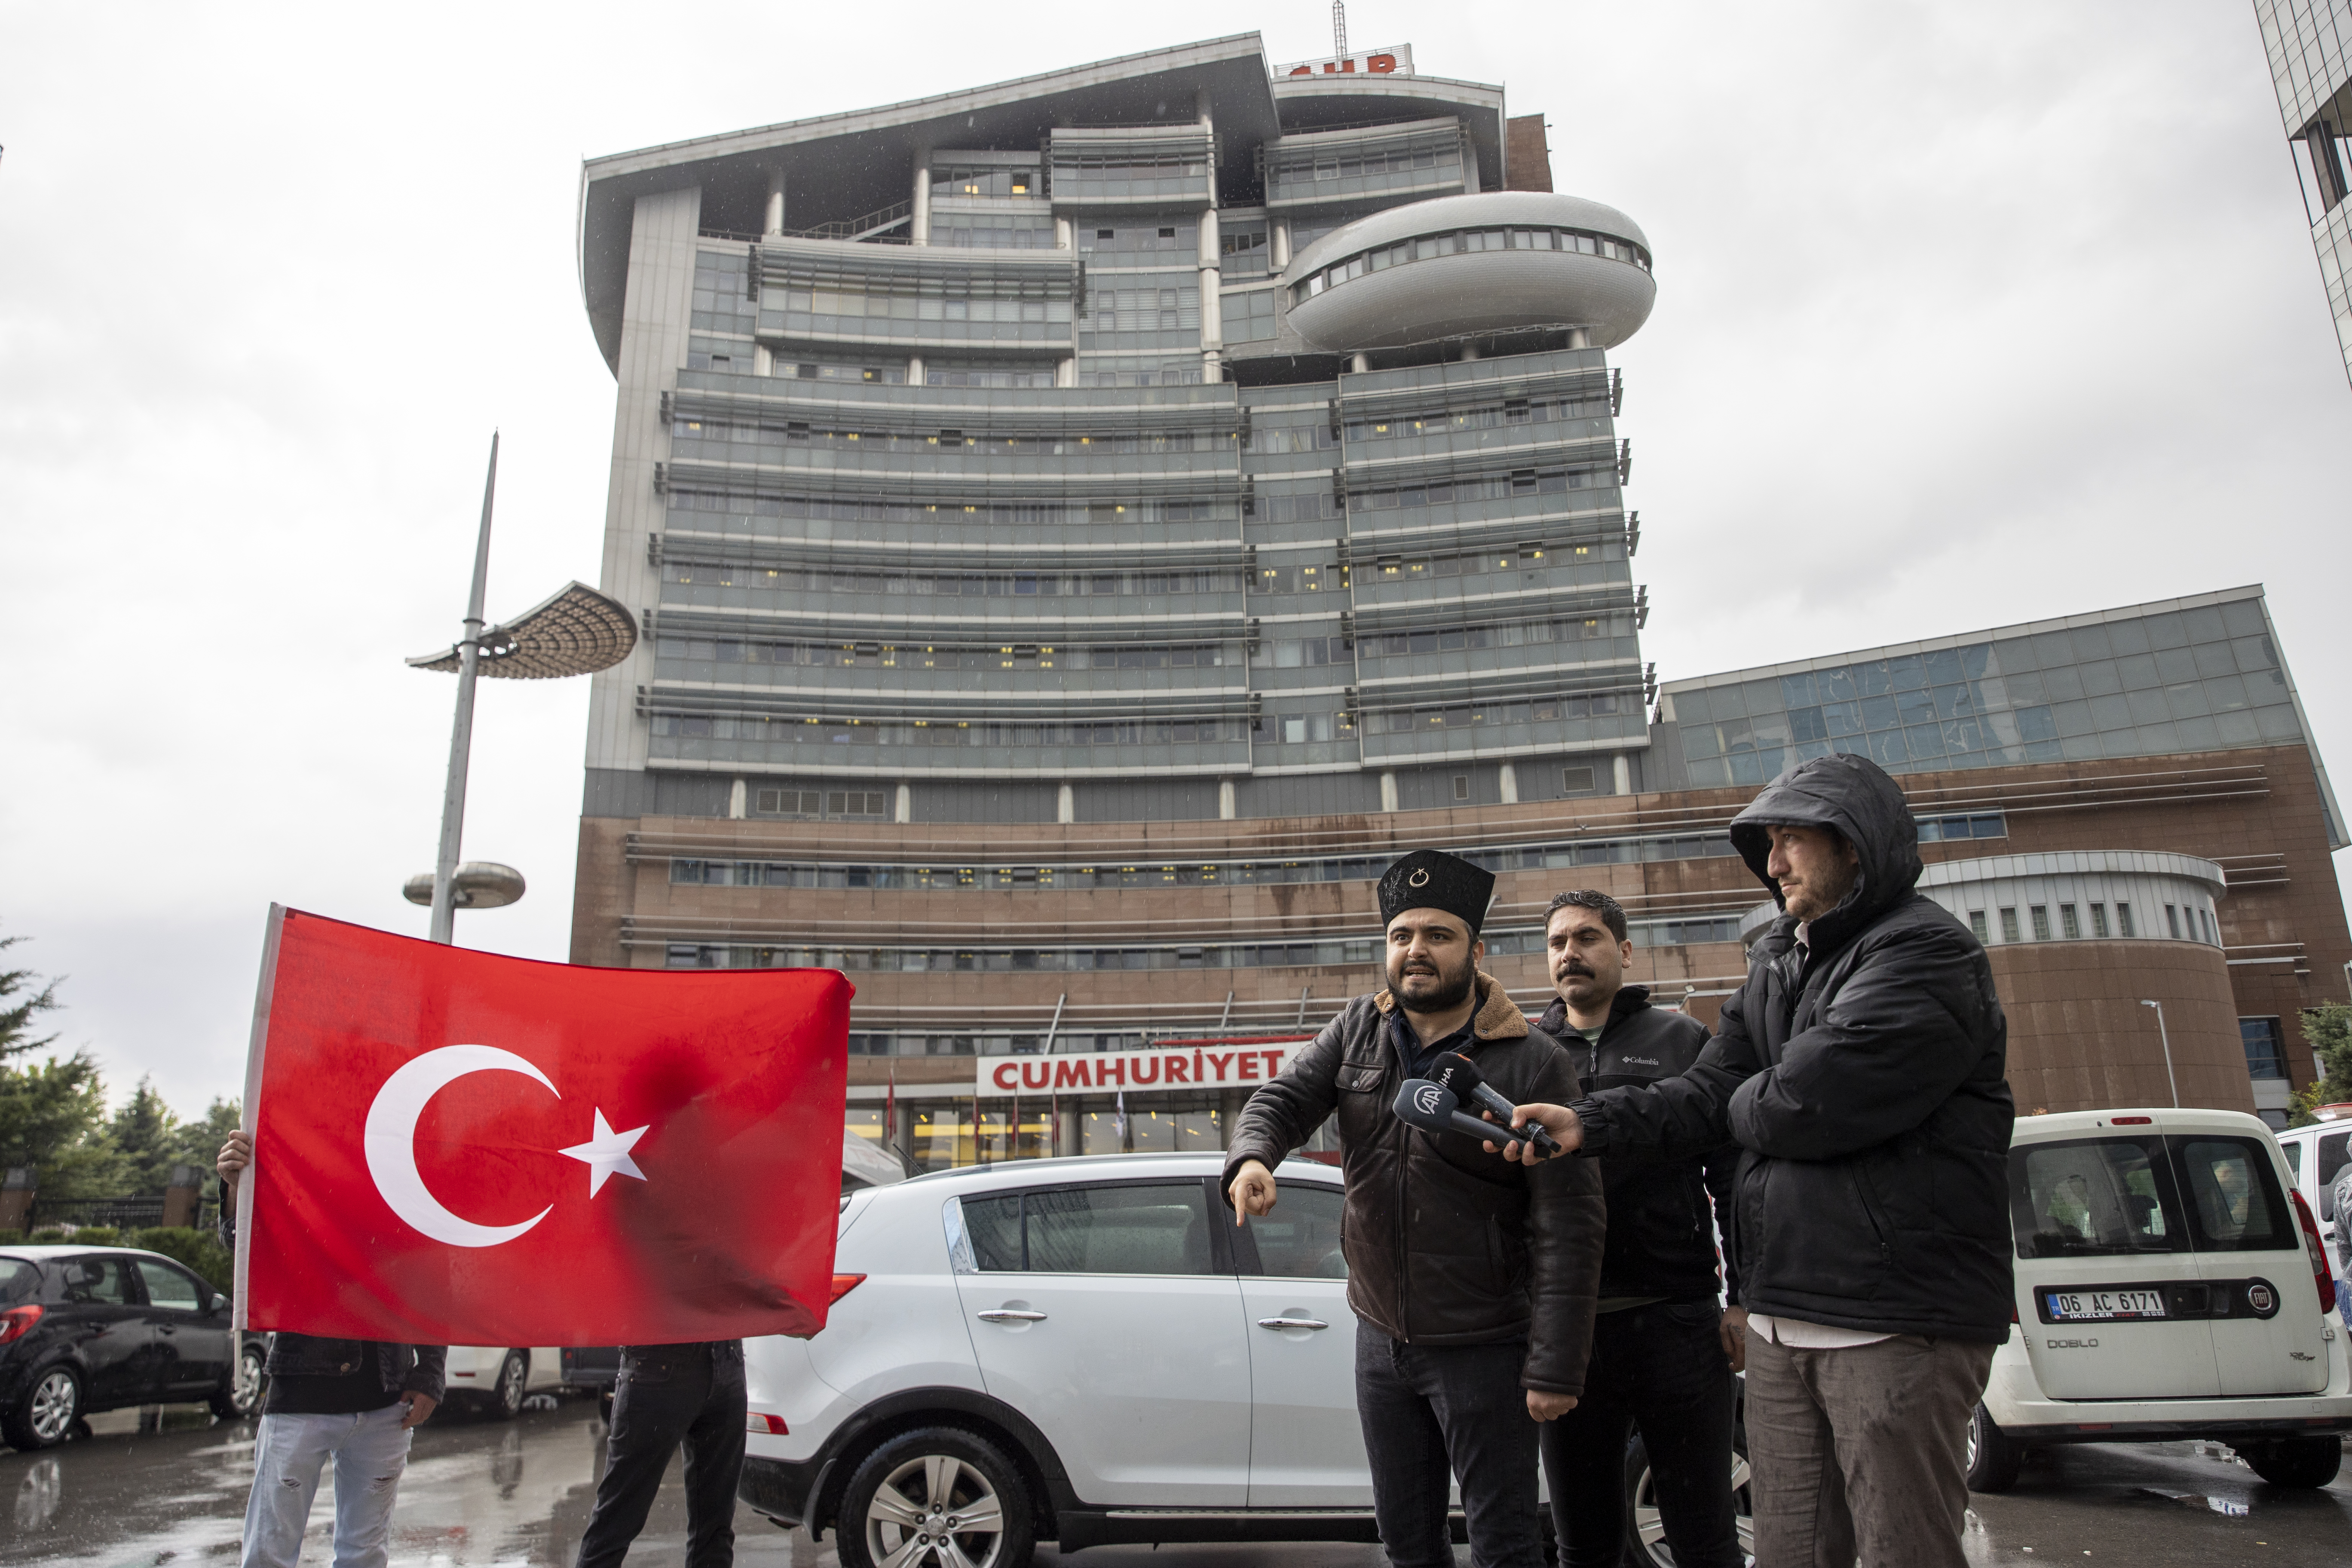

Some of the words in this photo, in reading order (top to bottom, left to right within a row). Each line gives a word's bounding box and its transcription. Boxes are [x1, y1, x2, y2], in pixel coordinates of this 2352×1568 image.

[992, 1048, 1284, 1090] CUMHURİYET
[1630, 1057, 1659, 1066] Columbia
[1421, 1090, 1442, 1115] AA
[2059, 1295, 2081, 1312] 06
[2092, 1294, 2113, 1311] AC
[2118, 1292, 2159, 1310] 6171
[2254, 1292, 2268, 1304] FIAT
[2047, 1338, 2098, 1349] DOBLO
